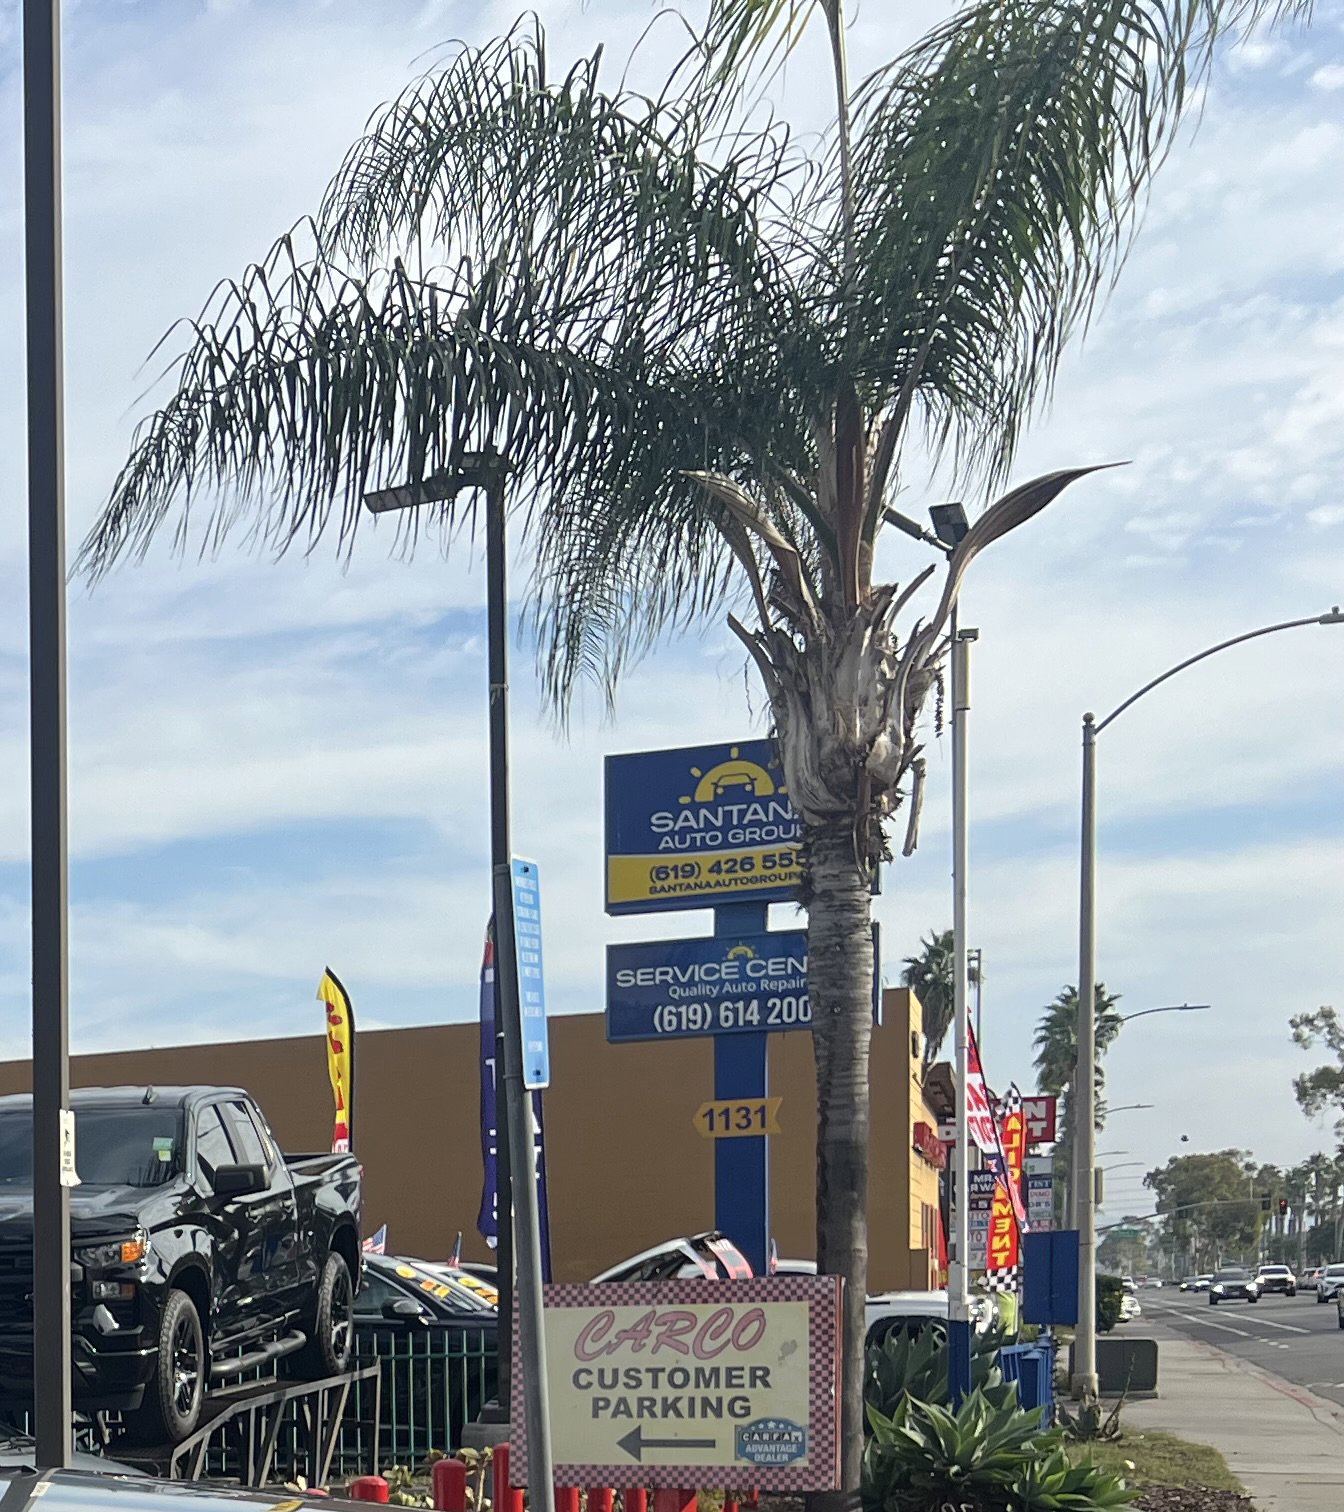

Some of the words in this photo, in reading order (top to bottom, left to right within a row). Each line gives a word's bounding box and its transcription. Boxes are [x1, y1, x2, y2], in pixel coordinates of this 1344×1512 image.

[650, 800, 799, 833] SANTAN
[658, 831, 722, 850] AUTO
[649, 861, 701, 884] (619)
[708, 856, 755, 875] 426
[616, 962, 739, 988] SERVICE
[746, 956, 808, 978] CEN
[668, 983, 719, 999] Quality
[722, 981, 756, 994] Auto
[760, 977, 807, 993] Repair
[653, 1002, 712, 1033] (619)
[719, 999, 760, 1028] 614
[767, 995, 812, 1024] 200
[702, 1105, 767, 1131] 1131
[574, 1306, 767, 1361] CARCO
[572, 1366, 772, 1390] CUSTOMER
[591, 1395, 751, 1419] PARKING
[746, 1444, 797, 1454] ADVANTAGE
[754, 1454, 789, 1462] DEALER
